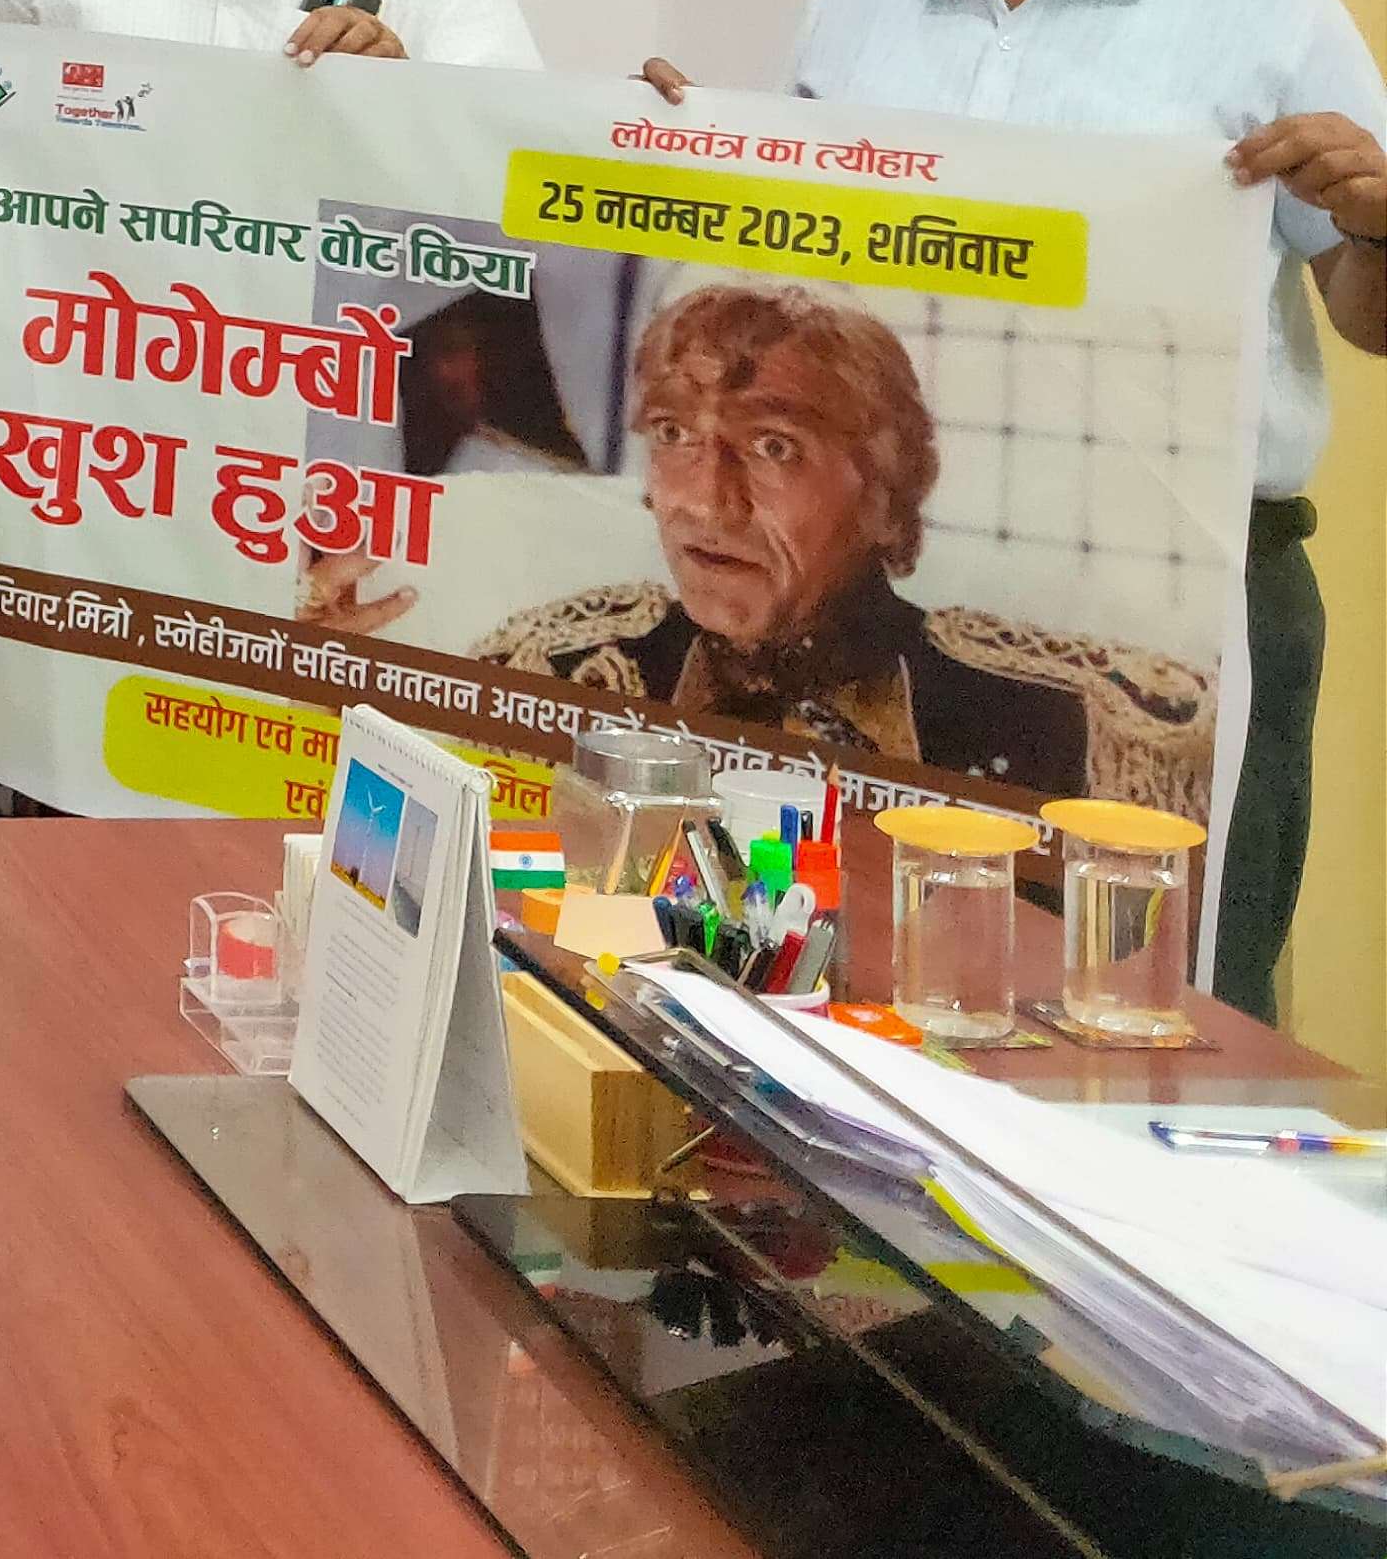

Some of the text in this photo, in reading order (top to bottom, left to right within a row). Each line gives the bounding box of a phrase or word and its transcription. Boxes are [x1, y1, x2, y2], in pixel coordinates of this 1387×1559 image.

[611, 119, 944, 182] लोकतंत्र का त्यौहार
[122, 200, 306, 263] सपरिवार
[320, 218, 397, 268] वोट
[411, 227, 529, 293] किया
[539, 181, 1034, 280] 25 नवम्बर 2023, शनिवार
[22, 271, 409, 425] मोगेम्बों
[212, 445, 444, 566] हुआ
[153, 610, 289, 671] स्नेहीजनों
[291, 640, 371, 690] सहित
[375, 661, 482, 715] मतदान
[489, 687, 583, 740] अवश्य
[144, 692, 249, 744] सहयोग
[254, 714, 296, 755] एवं
[284, 779, 327, 821] एवं
